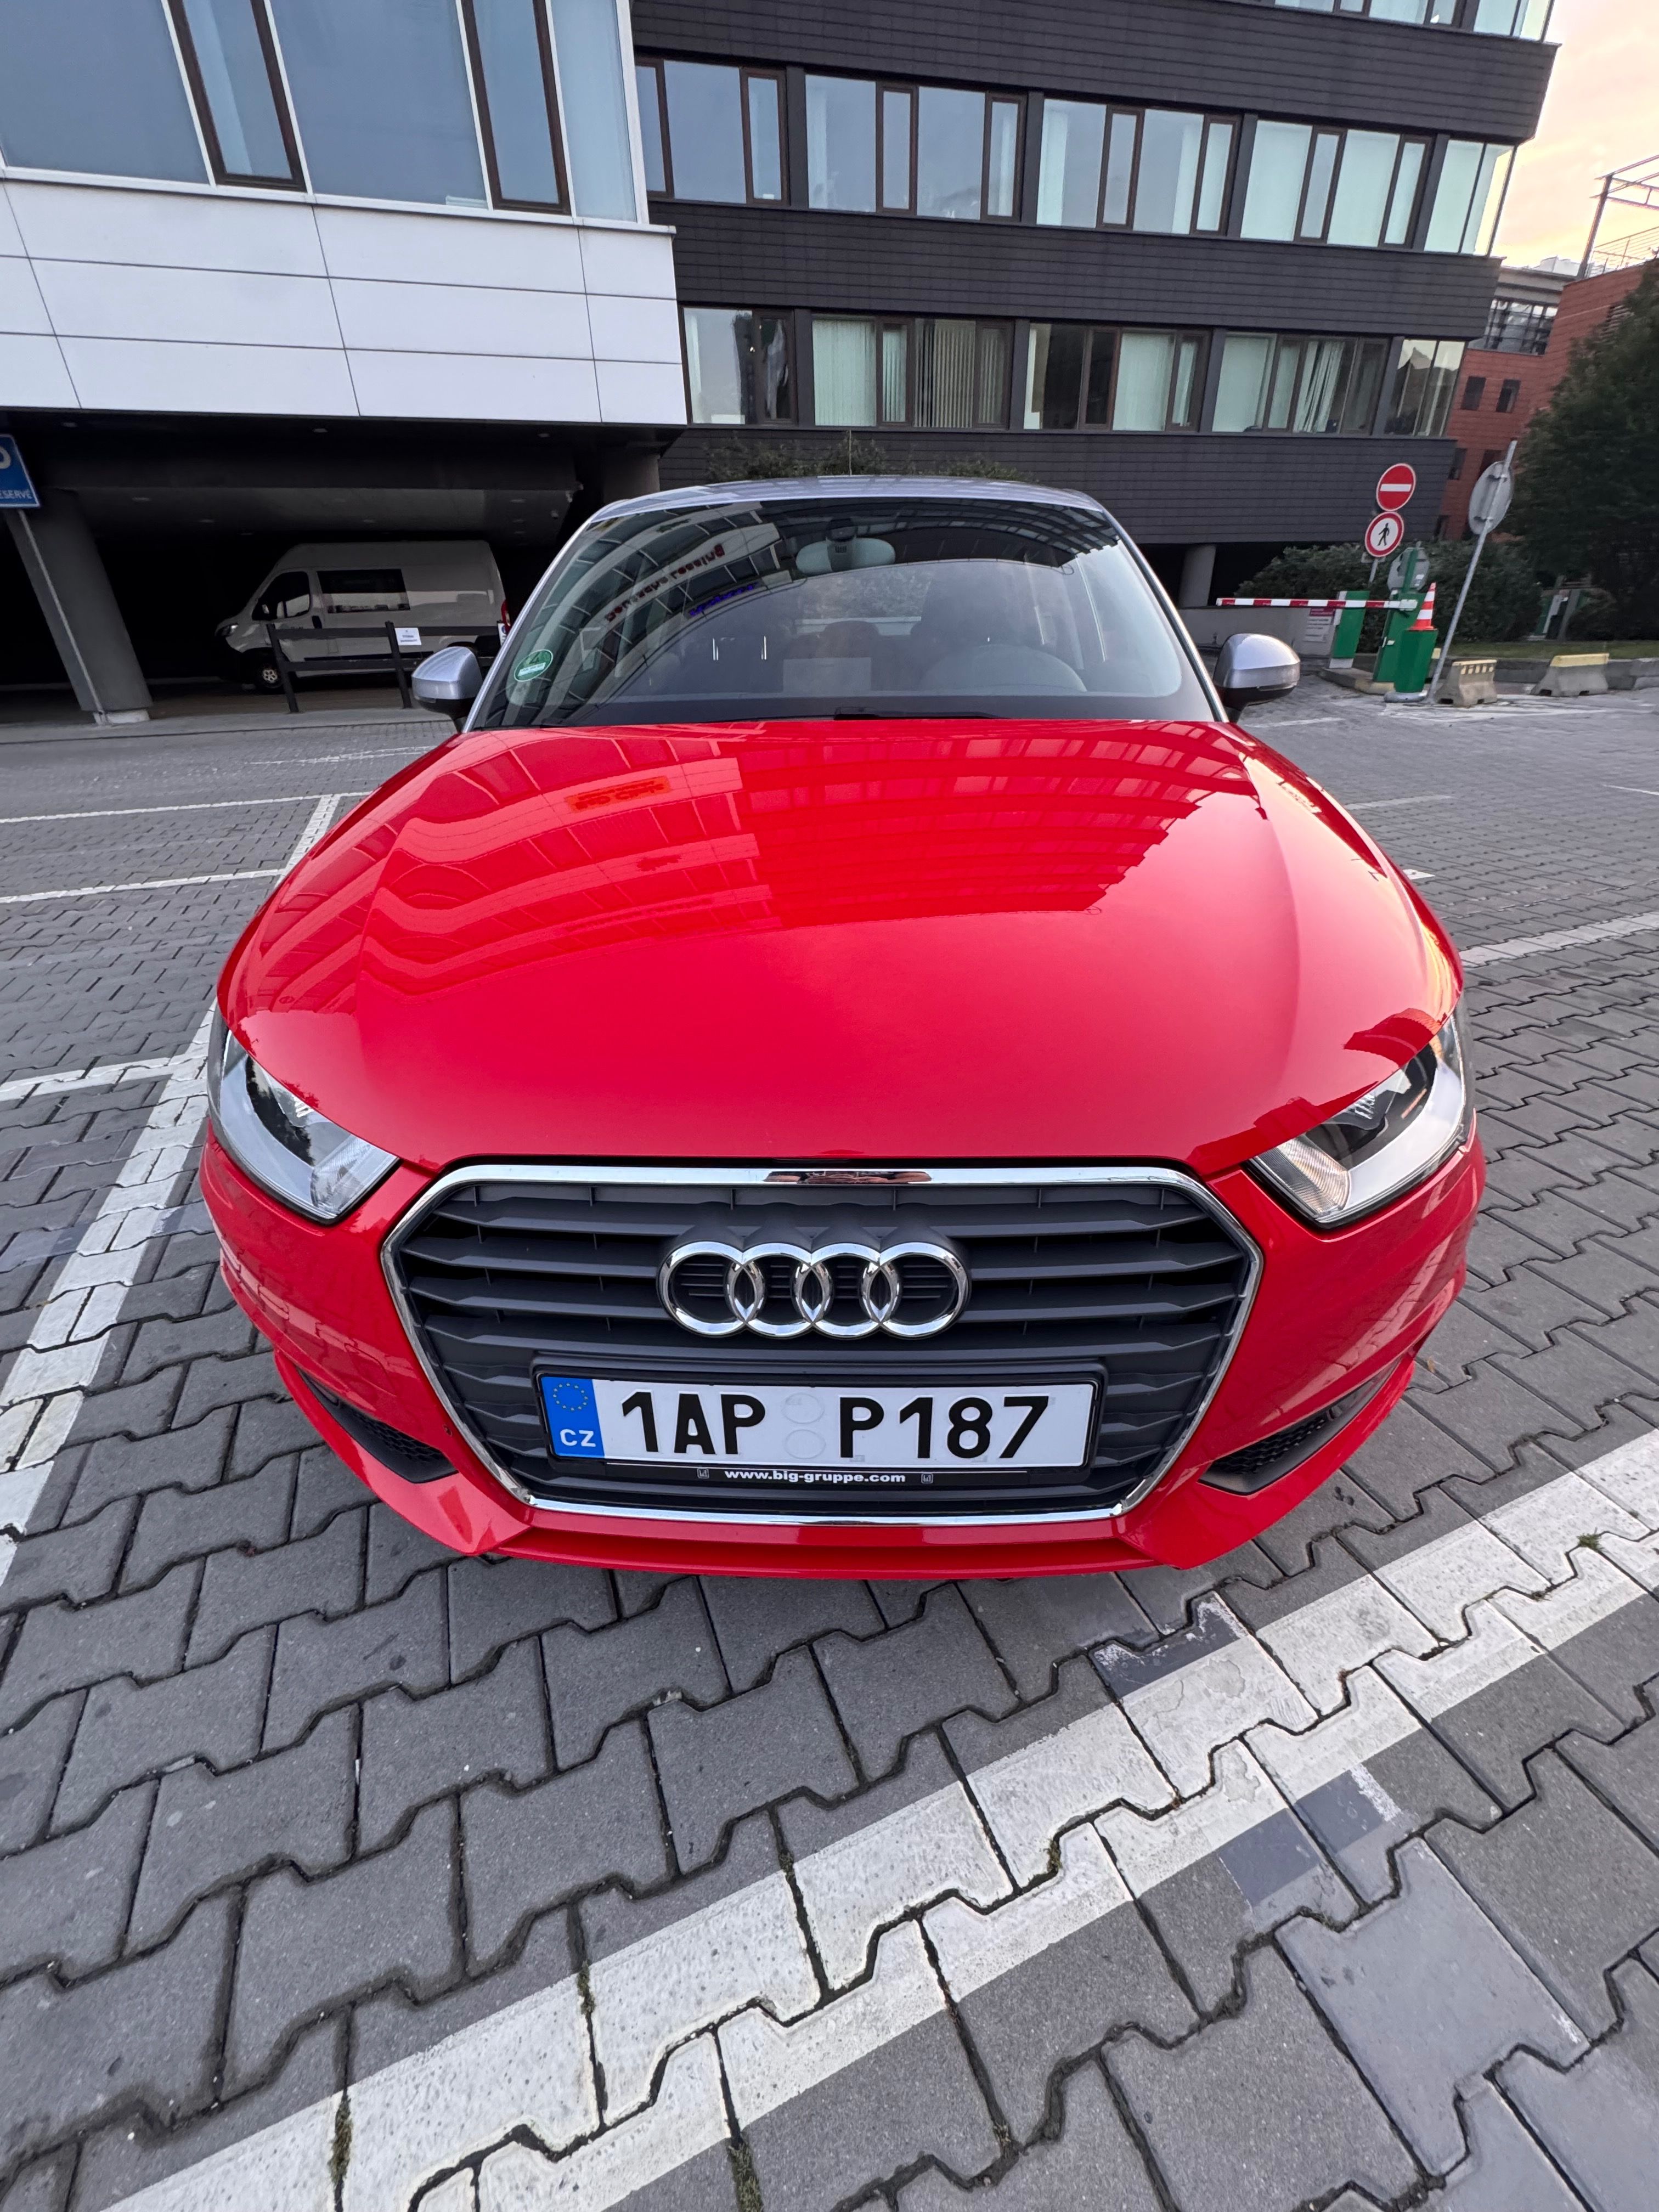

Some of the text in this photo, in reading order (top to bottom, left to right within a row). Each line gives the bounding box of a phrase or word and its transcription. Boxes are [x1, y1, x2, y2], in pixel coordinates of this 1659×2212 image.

[528, 651, 540, 665] 4
[622, 1391, 1049, 1459] 1AP P187
[560, 1429, 596, 1447] CZ
[724, 1470, 906, 1483] www.big-gruppe.com
